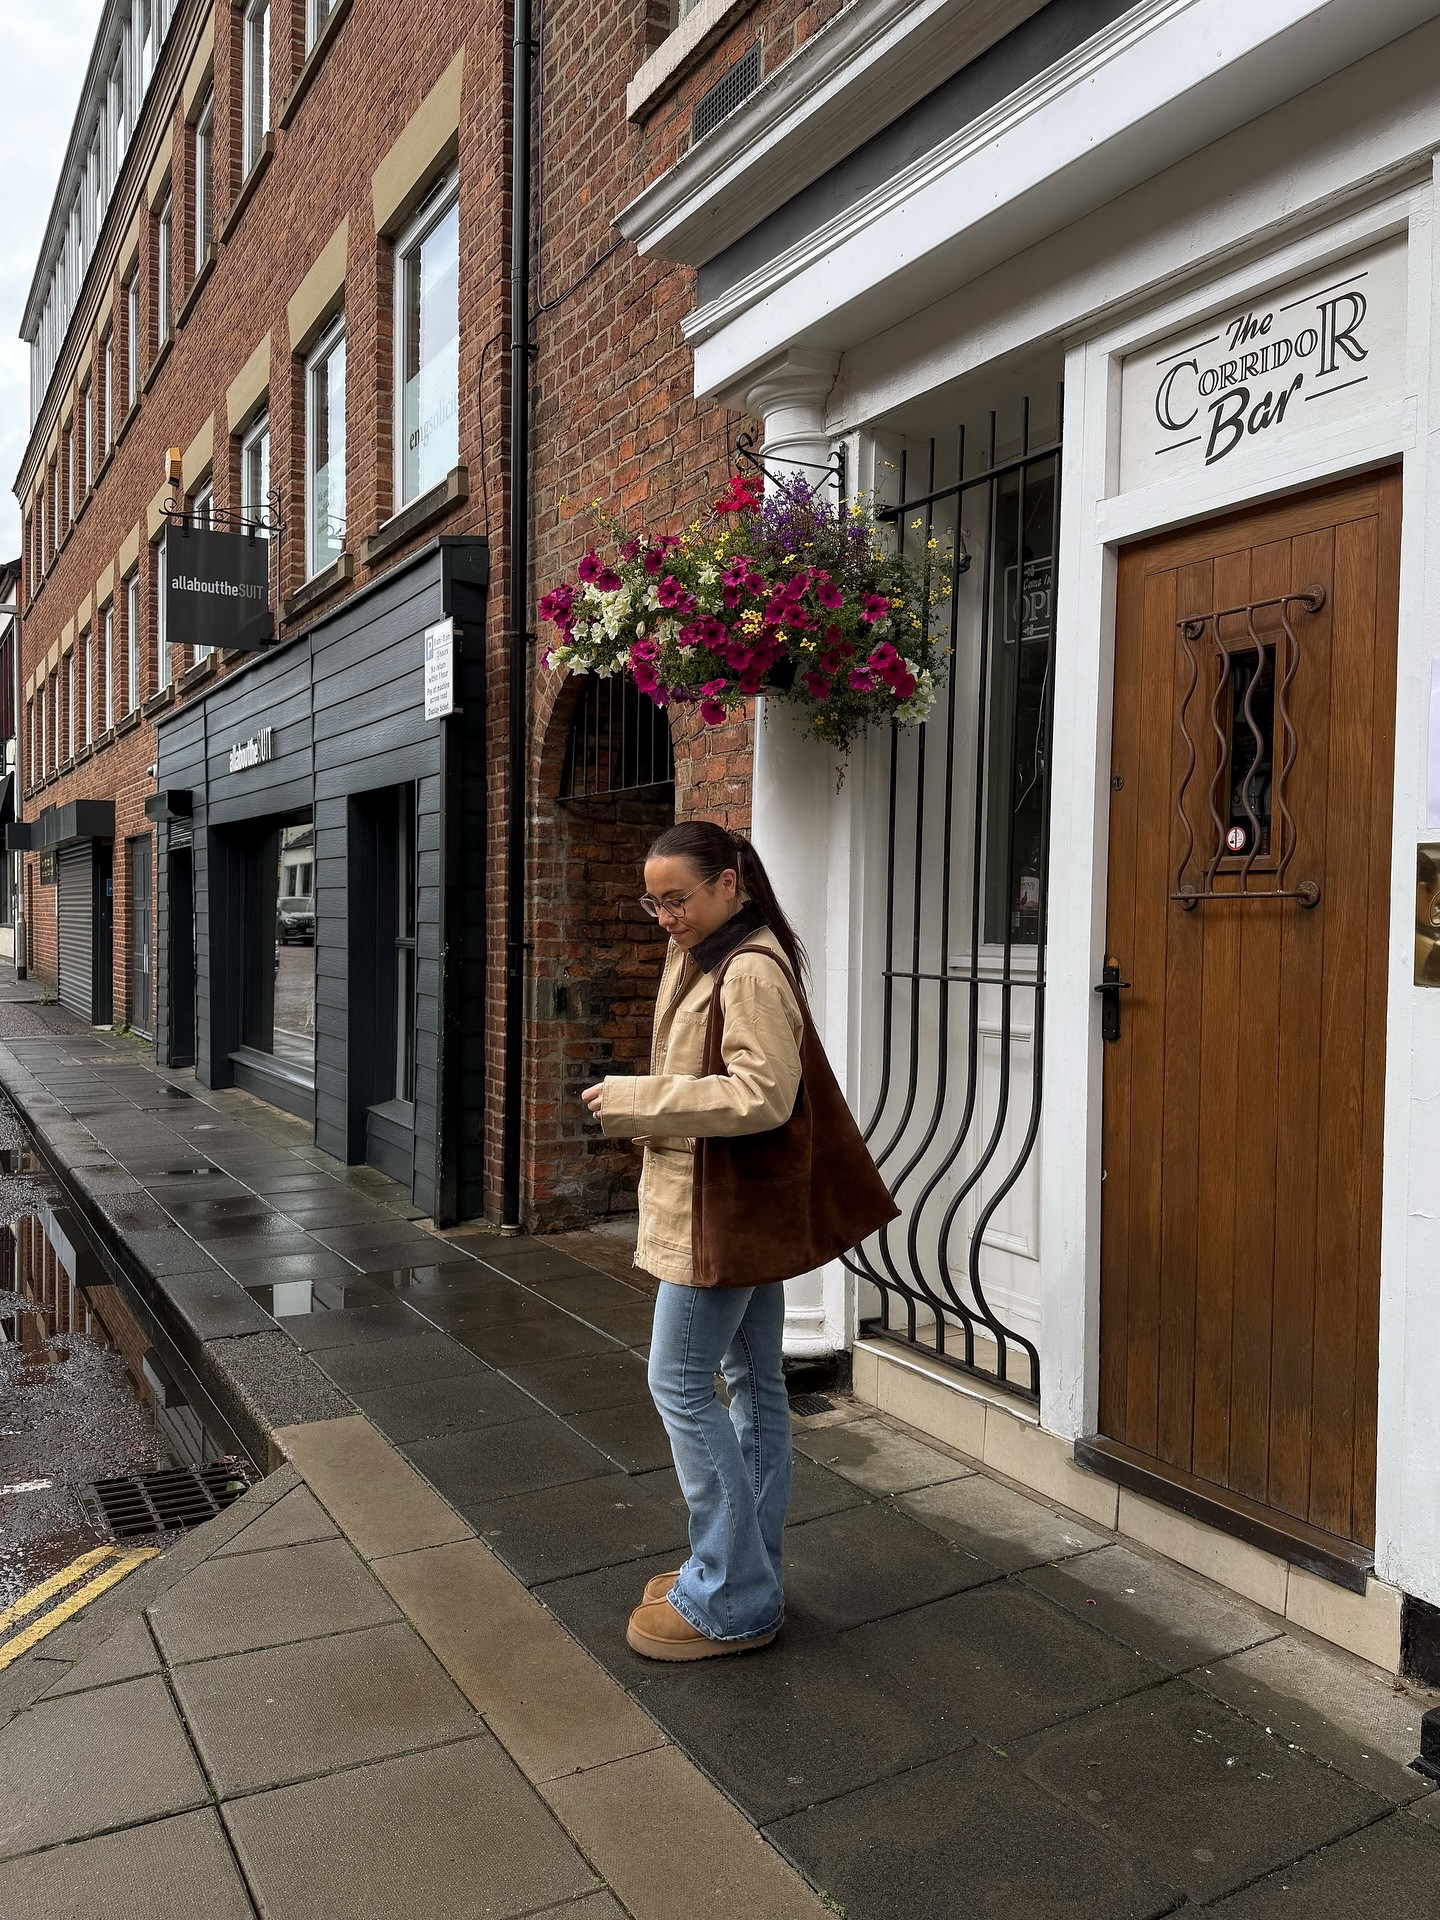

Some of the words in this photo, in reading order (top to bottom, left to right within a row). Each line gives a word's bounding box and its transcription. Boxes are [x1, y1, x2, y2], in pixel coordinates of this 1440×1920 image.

[1225, 311, 1274, 351] The
[1205, 372, 1304, 466] Bar
[172, 575, 264, 600] allabouttheSUIT
[1023, 578, 1042, 590] Come
[1012, 589, 1052, 623] OP
